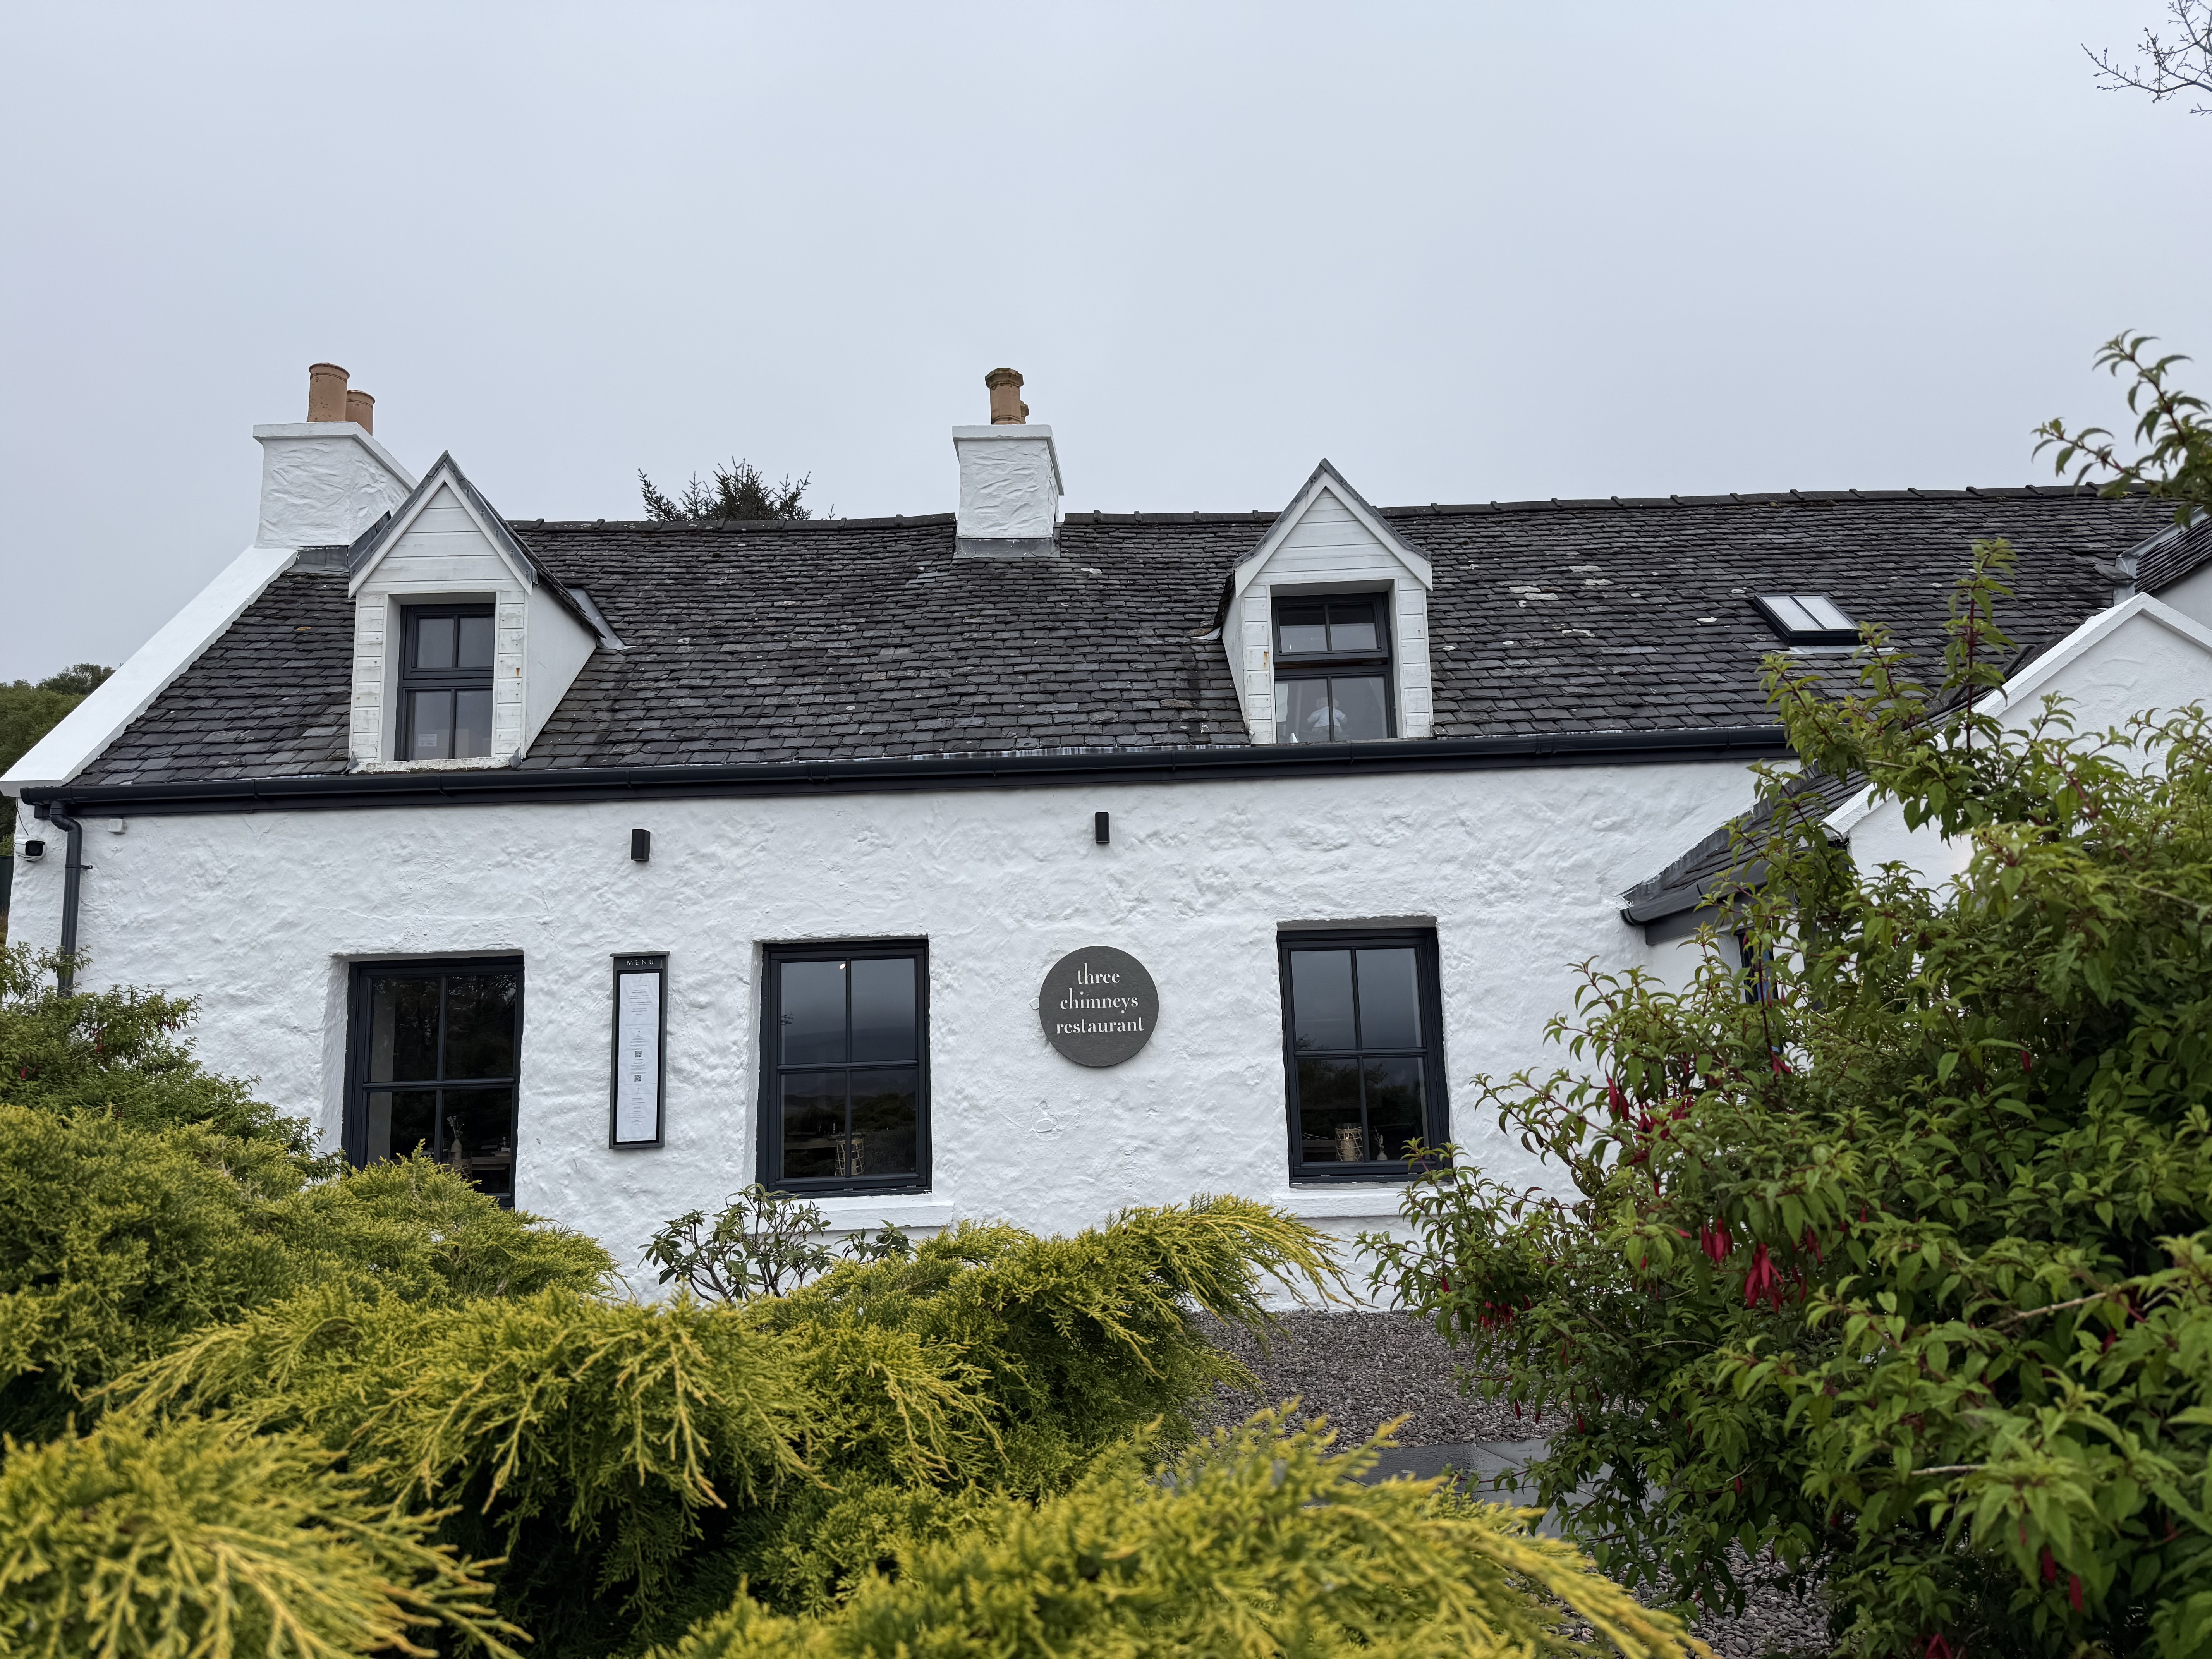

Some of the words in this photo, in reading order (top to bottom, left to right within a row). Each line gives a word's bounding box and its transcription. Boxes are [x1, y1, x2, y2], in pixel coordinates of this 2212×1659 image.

[1078, 963, 1120, 984] three
[1060, 988, 1138, 1013] chimneys
[1056, 1017, 1145, 1034] restaurant
